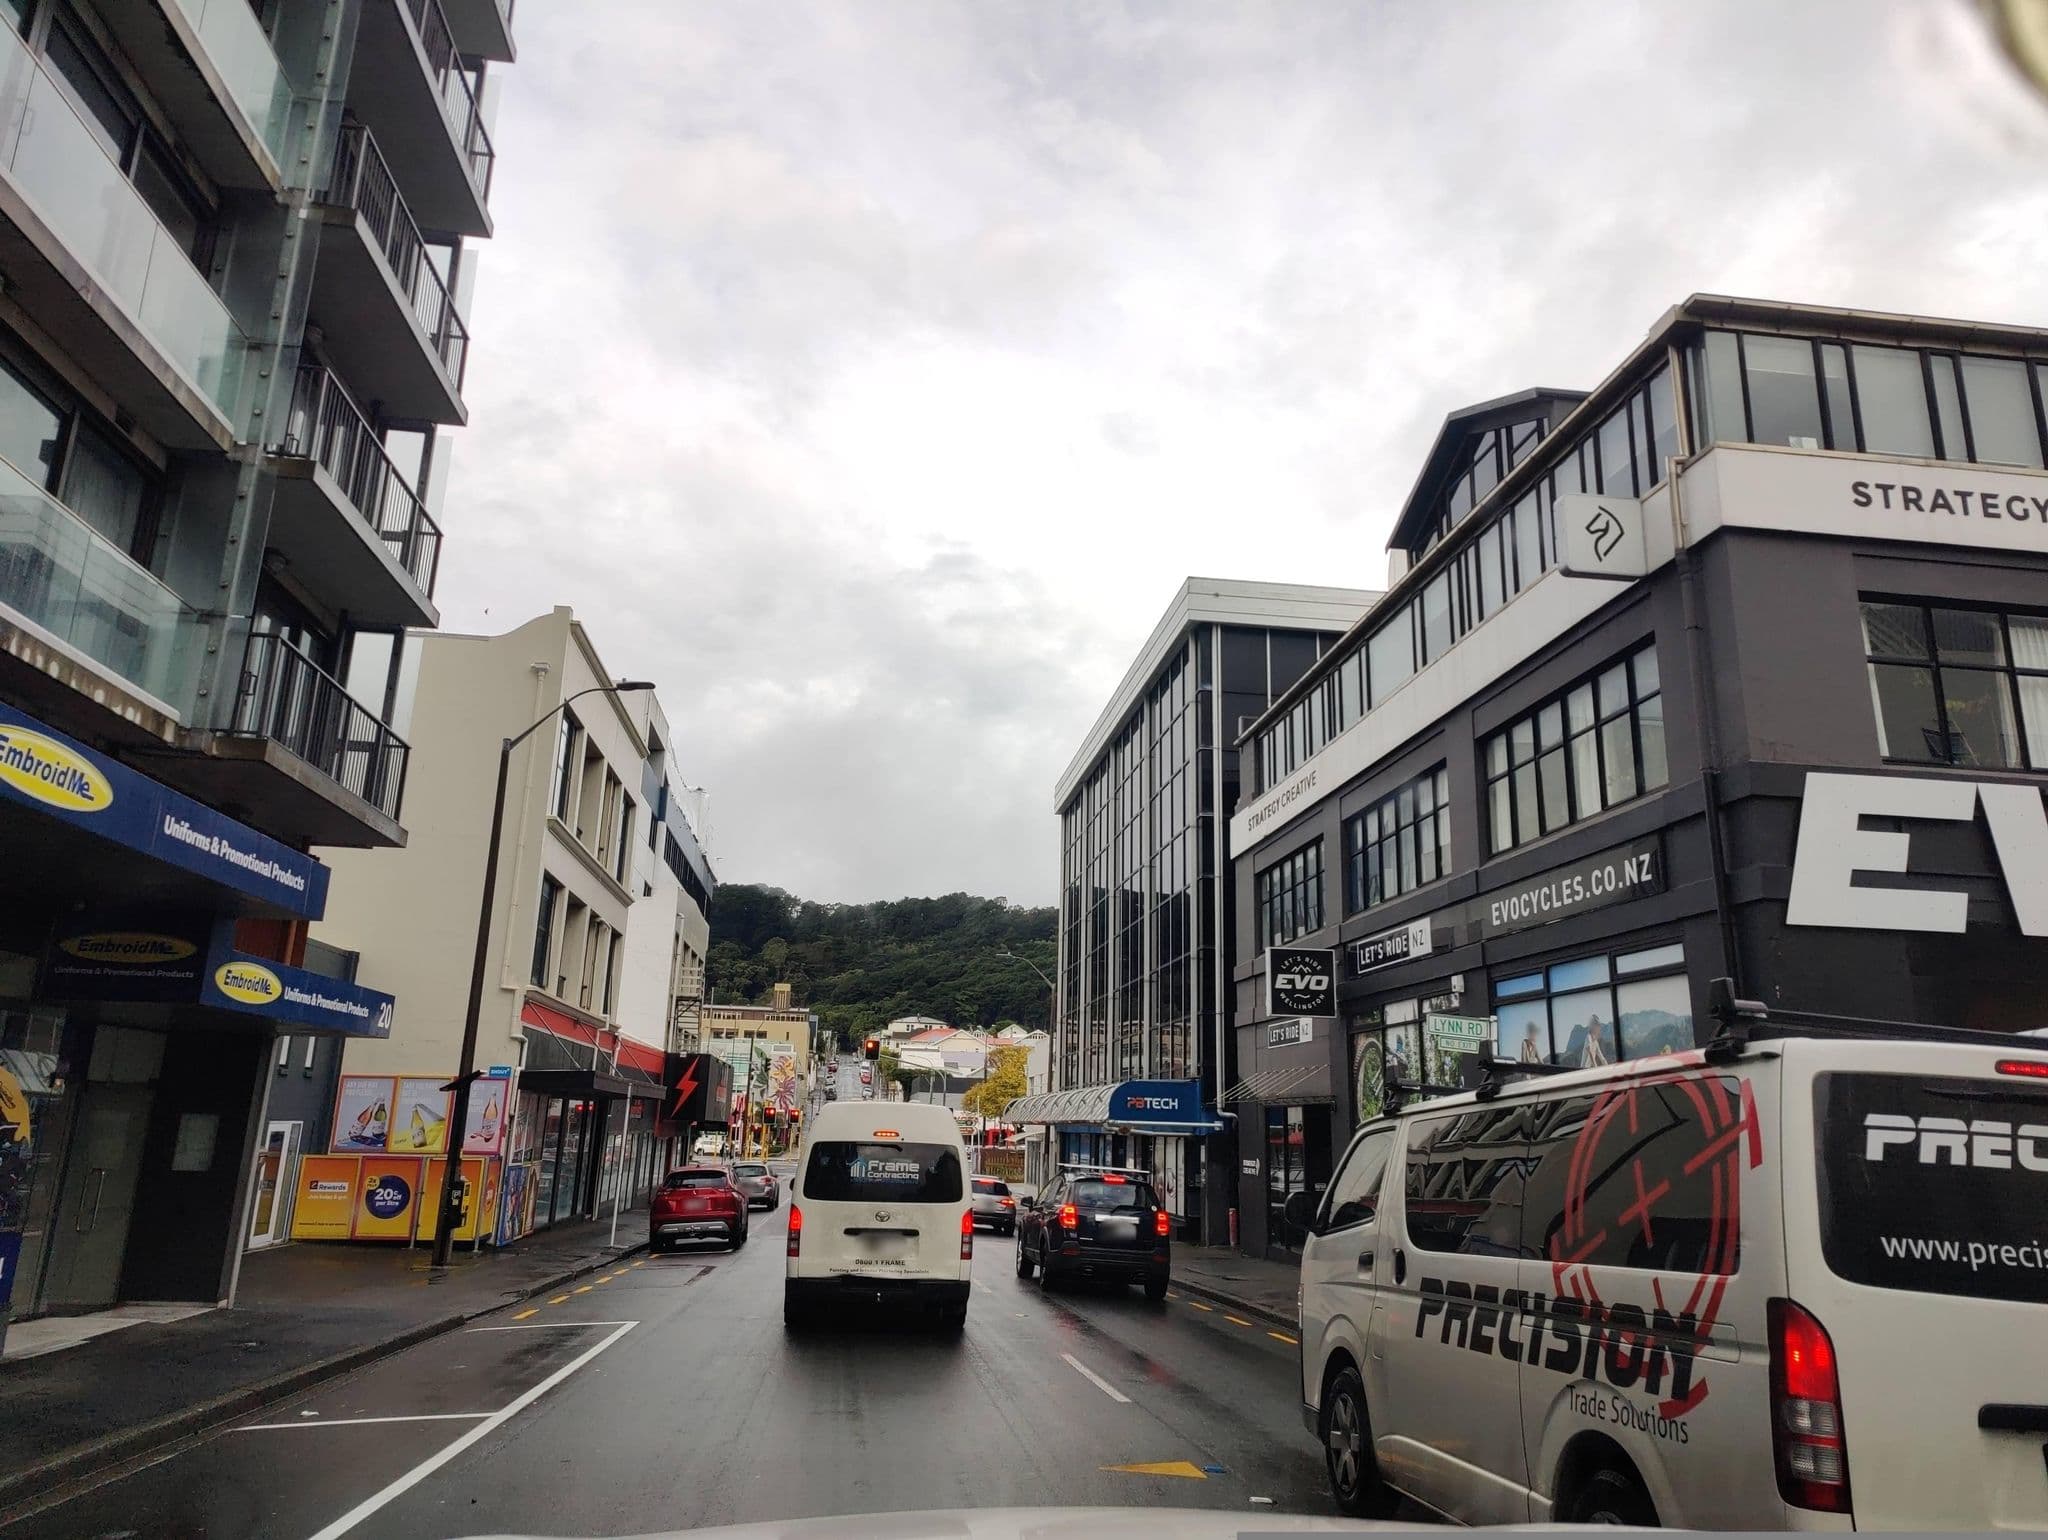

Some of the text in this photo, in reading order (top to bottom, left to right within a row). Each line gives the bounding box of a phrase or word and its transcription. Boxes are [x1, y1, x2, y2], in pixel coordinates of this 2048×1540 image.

[1852, 481, 2048, 523] STRATEGY
[1248, 770, 1317, 832] STRATEGY CREATIVE
[163, 814, 305, 891] Uniforms & Promotional Products
[1491, 852, 1653, 926] EVOCYCLES.CO.NZ
[1360, 929, 1424, 965] LET'S RIDE NZ
[1280, 955, 1322, 970] LET'S RIDE
[223, 969, 273, 996] EmbroidMe
[1274, 973, 1330, 991] EVO
[284, 986, 370, 1018] Uniforms & Promotional Products
[1280, 992, 1326, 1010] WELLINGTON
[377, 1002, 393, 1029] 20
[1433, 1018, 1483, 1036] LYNN RD
[1270, 1029, 1285, 1042] LET'S
[1285, 1025, 1299, 1040] RIDE
[867, 1171, 919, 1180] Contracting
[868, 1160, 920, 1172] Frame
[1415, 1277, 1697, 1400] PRECISION
[1566, 1384, 1690, 1445] Trade Solutions
